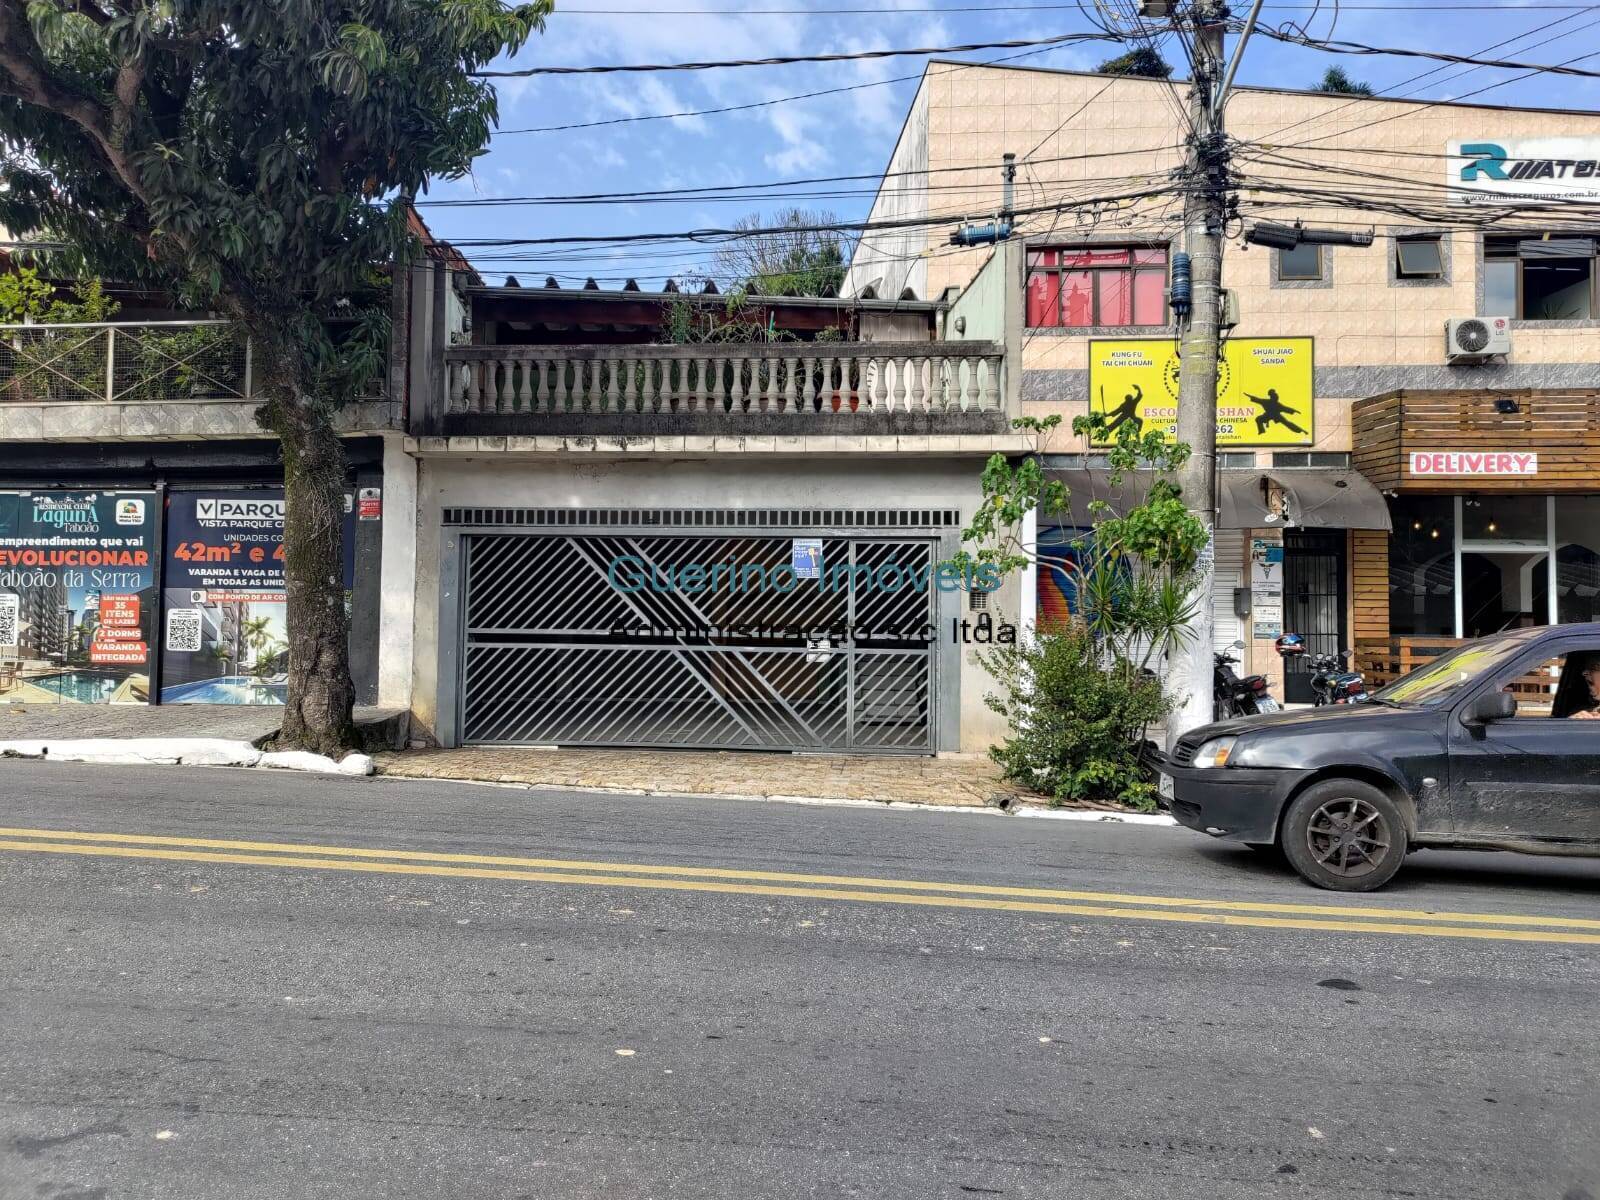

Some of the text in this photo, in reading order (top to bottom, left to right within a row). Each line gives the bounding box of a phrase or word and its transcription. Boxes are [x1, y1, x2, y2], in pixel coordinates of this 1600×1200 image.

[1143, 407, 1175, 417] ESCO
[1414, 453, 1532, 473] DELIVERY
[220, 503, 285, 518] PARQU
[64, 521, 100, 533] Taboão
[230, 520, 272, 529] PARQUE
[0, 536, 144, 549] empreendimento que vai
[223, 534, 285, 542] UNIDADES CO
[0, 550, 148, 566] EVOLUCIONAR
[249, 547, 265, 562] e
[188, 568, 232, 576] VARANDA
[0, 567, 141, 588] aboão da Serra
[114, 601, 126, 609] 35
[105, 610, 135, 618] ITENS
[96, 643, 141, 651] VARANDA
[91, 653, 145, 661] INTEGRADA
